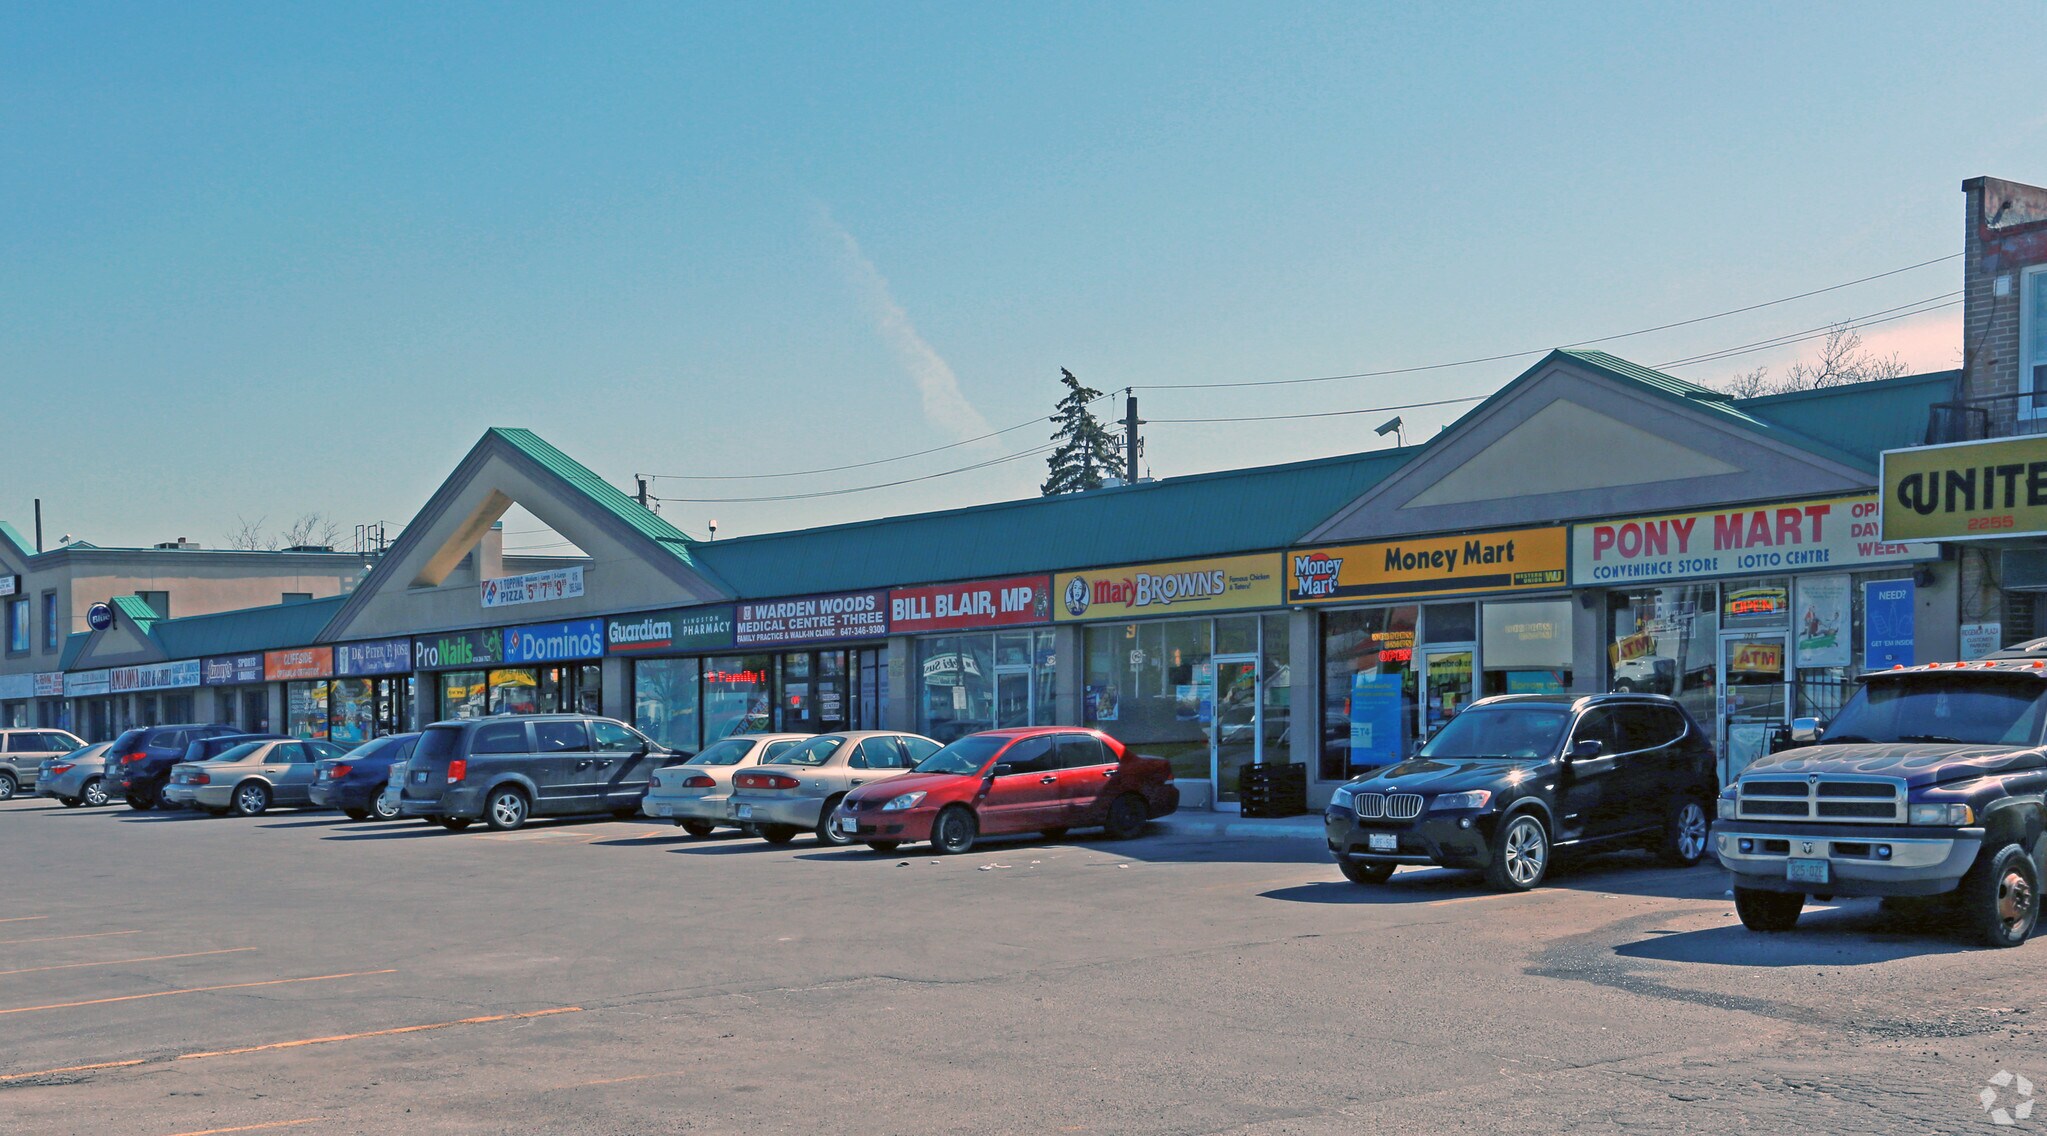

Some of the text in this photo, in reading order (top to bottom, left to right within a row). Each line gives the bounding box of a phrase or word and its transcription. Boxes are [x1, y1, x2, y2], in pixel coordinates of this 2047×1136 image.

[1851, 502, 1879, 518] OP
[1967, 515, 2014, 530] 2255
[1593, 504, 1831, 561] PONY MART
[1384, 539, 1515, 572] Money Mart
[1294, 555, 1344, 581] Money
[1593, 548, 1830, 579] CONVENIENCE STORE LOTTO CENTRE
[503, 576, 524, 590] TOPPING
[1229, 573, 1270, 583] Famous Chicken
[1297, 575, 1338, 596] Mart
[500, 589, 524, 603] PIZZA
[1092, 577, 1138, 608] Mary
[1878, 590, 1907, 601] NEED?
[755, 595, 876, 620] WARDEN WOODS
[892, 587, 1033, 621] BILL BLAIR, MP
[1731, 599, 1774, 613] OPEN
[682, 615, 719, 624] KINGSTON
[737, 620, 785, 633] MEDICAL
[788, 615, 835, 629] CENTRE
[841, 611, 884, 625] THREE
[608, 618, 672, 643] Guardian
[683, 621, 731, 636] PHARMACY
[737, 633, 756, 643] FAMILY
[756, 632, 784, 641] PRACTICE
[790, 630, 815, 639] WALK-IN
[815, 628, 836, 638] CLINIC
[1371, 631, 1414, 641] WESTERN
[522, 623, 601, 660] Domino's
[1894, 638, 1914, 646] INSIDE
[283, 651, 313, 665] CLIFFSIDE
[351, 647, 364, 660] DR.
[365, 645, 385, 659] PETER
[1378, 648, 1412, 662] OPEN
[1740, 649, 1776, 665] ATM
[237, 657, 256, 668] SPORTS
[718, 670, 758, 684] Family
